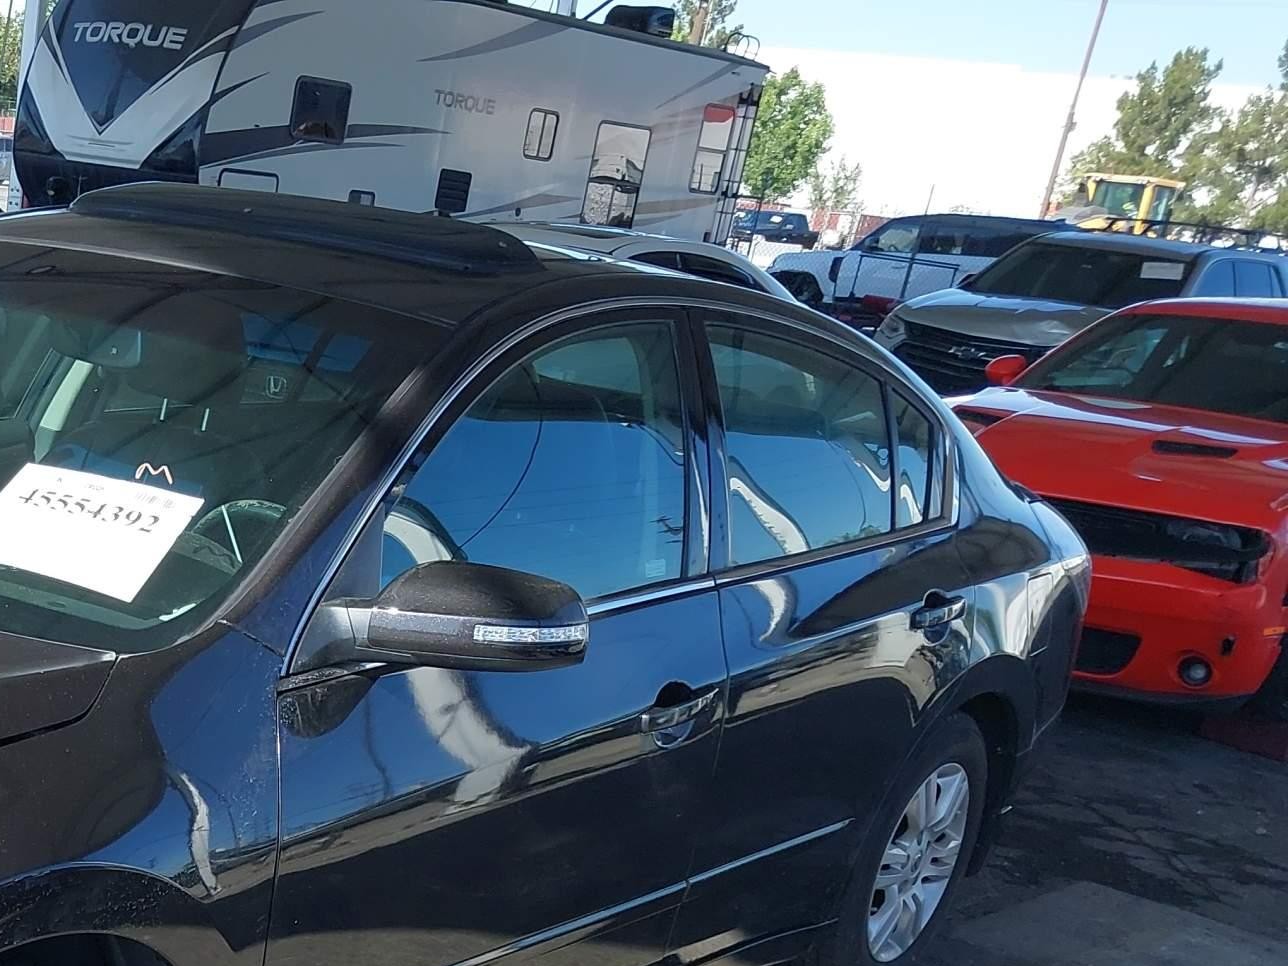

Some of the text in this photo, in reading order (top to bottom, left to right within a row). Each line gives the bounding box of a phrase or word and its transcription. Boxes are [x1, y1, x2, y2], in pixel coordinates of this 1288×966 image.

[74, 21, 188, 49] TORQUE
[434, 89, 496, 115] TORQUE
[19, 489, 159, 532] 45554392
